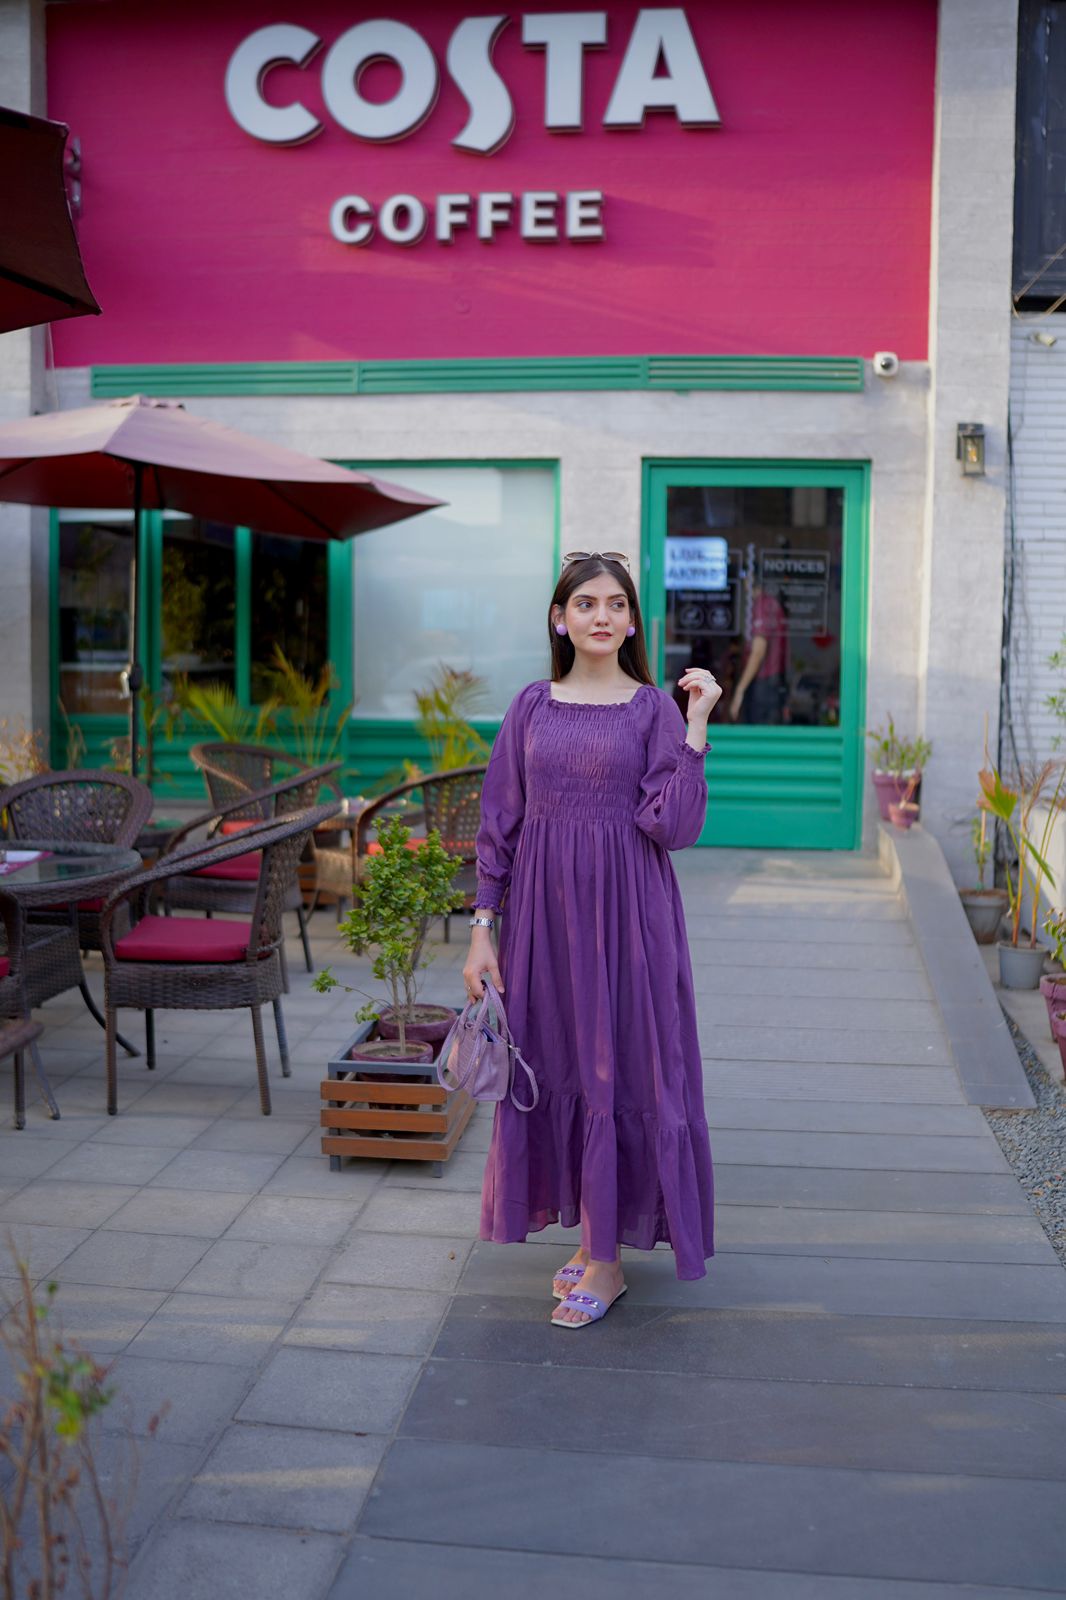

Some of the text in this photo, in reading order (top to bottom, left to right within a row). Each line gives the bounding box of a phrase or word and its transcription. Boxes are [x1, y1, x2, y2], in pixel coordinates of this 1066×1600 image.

[224, 7, 721, 156] COSTA
[330, 190, 606, 246] COFFEE
[764, 559, 826, 574] NOTICES
